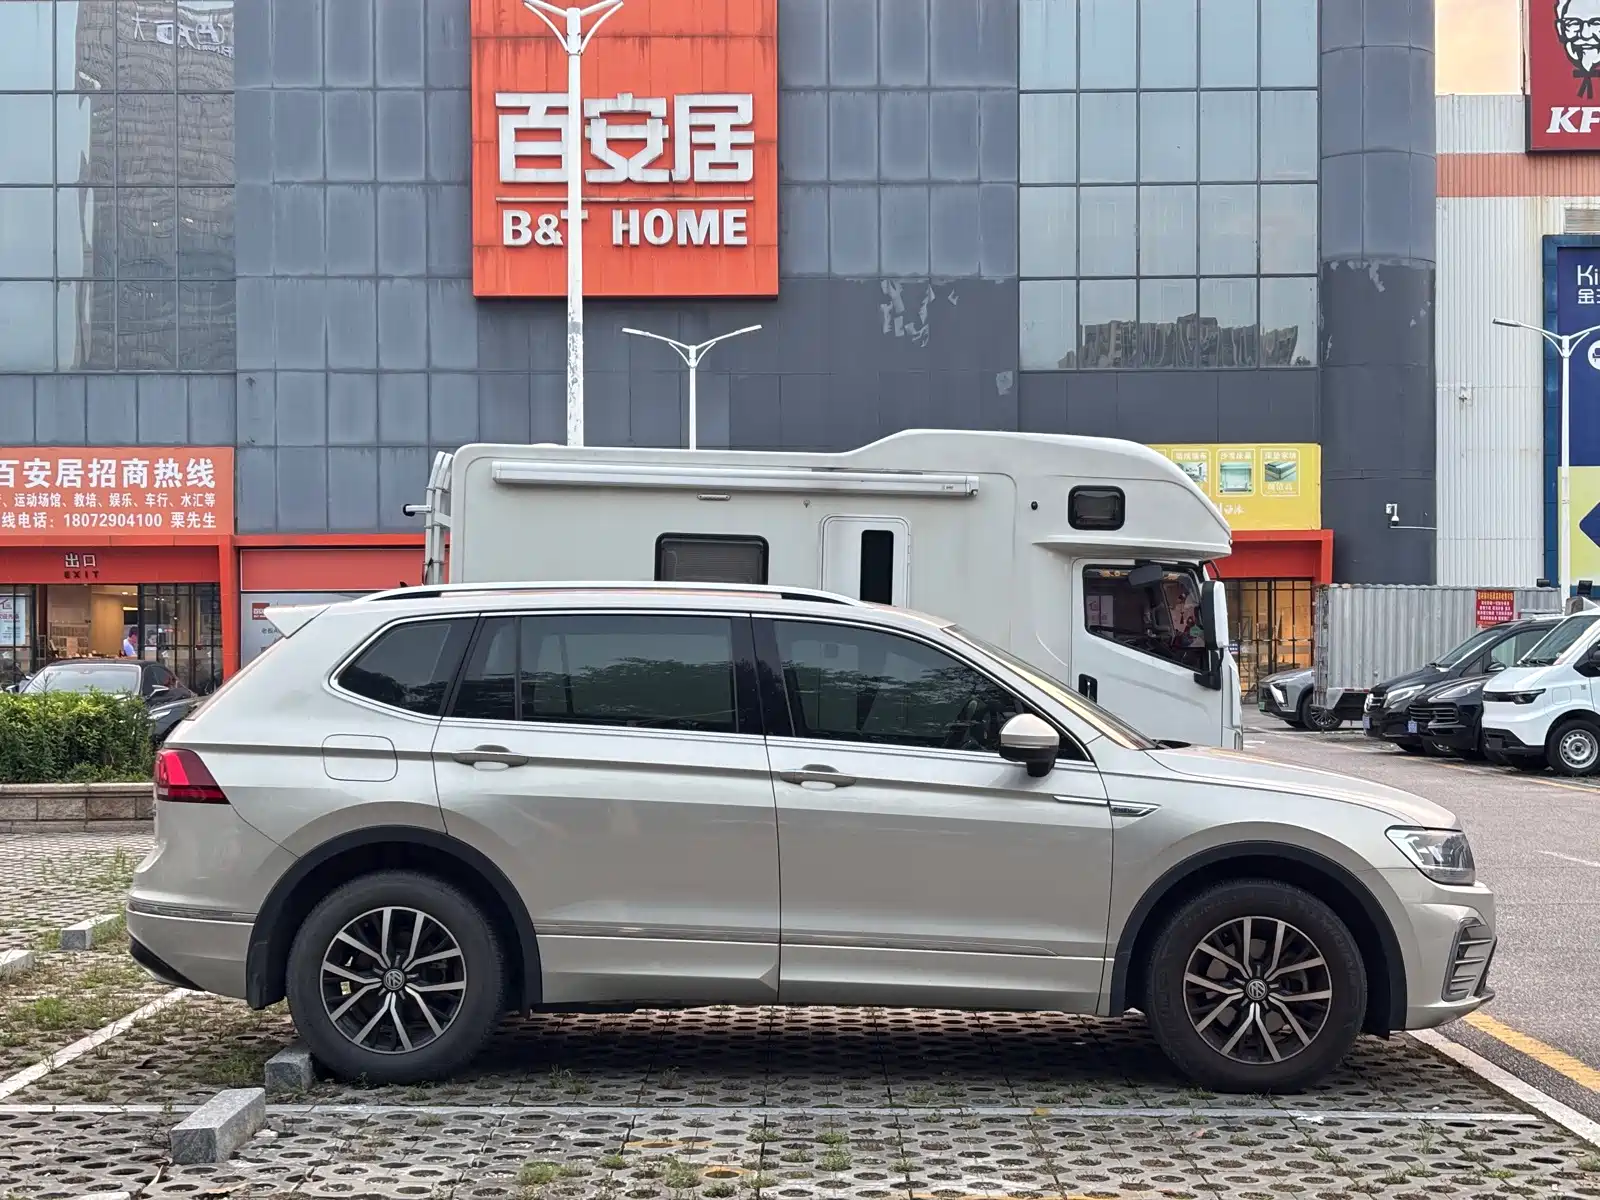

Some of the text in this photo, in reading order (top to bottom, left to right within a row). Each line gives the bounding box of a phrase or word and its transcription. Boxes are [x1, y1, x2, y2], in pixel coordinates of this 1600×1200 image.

[495, 92, 755, 184] 百安居
[612, 208, 748, 247] HOME
[0, 457, 216, 489] 百安居招商热线
[170, 511, 217, 529] 栗先生
[65, 553, 96, 568] 出口
[64, 570, 99, 579] EXIT
